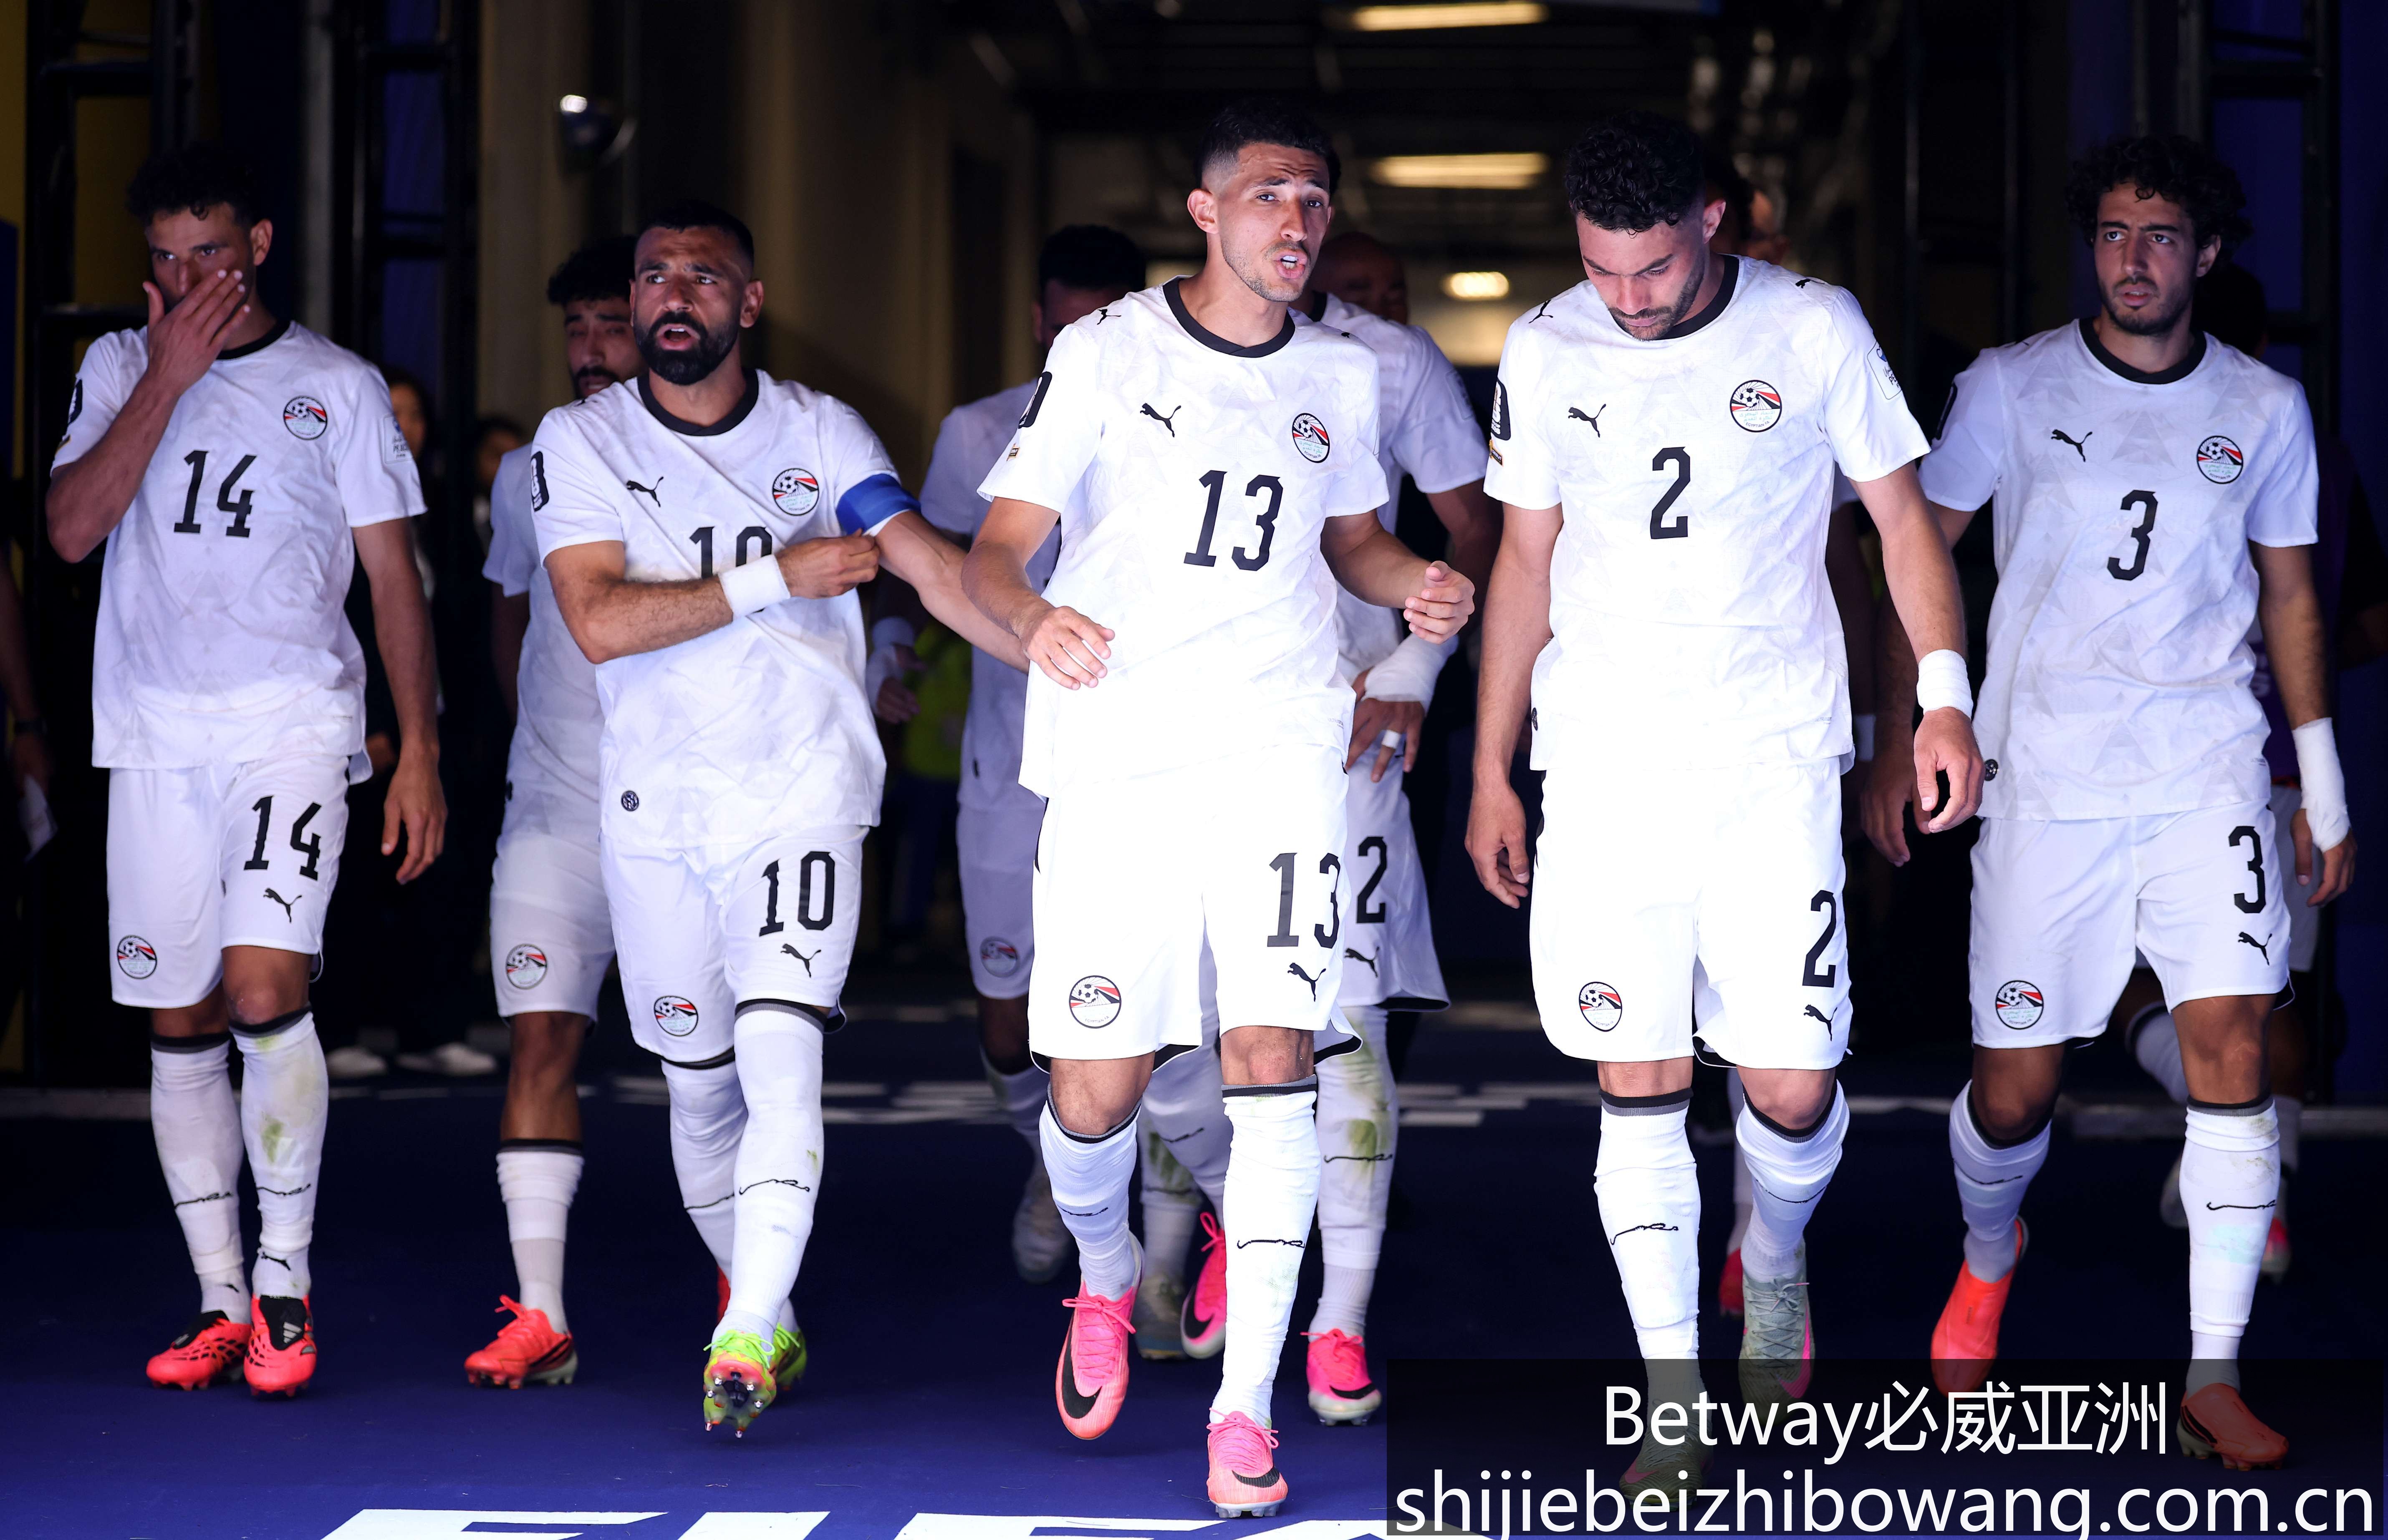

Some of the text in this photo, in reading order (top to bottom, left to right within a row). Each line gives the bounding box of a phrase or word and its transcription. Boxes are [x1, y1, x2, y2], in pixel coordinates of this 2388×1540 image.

[174, 450, 257, 538] 14
[1184, 470, 1283, 571] 13
[1650, 447, 1690, 539] 2
[2107, 490, 2158, 581] 3
[244, 796, 322, 881] 14
[2228, 826, 2266, 913] 3
[759, 851, 835, 937] 10
[1267, 853, 1340, 949] 13
[1802, 890, 1836, 988] 2
